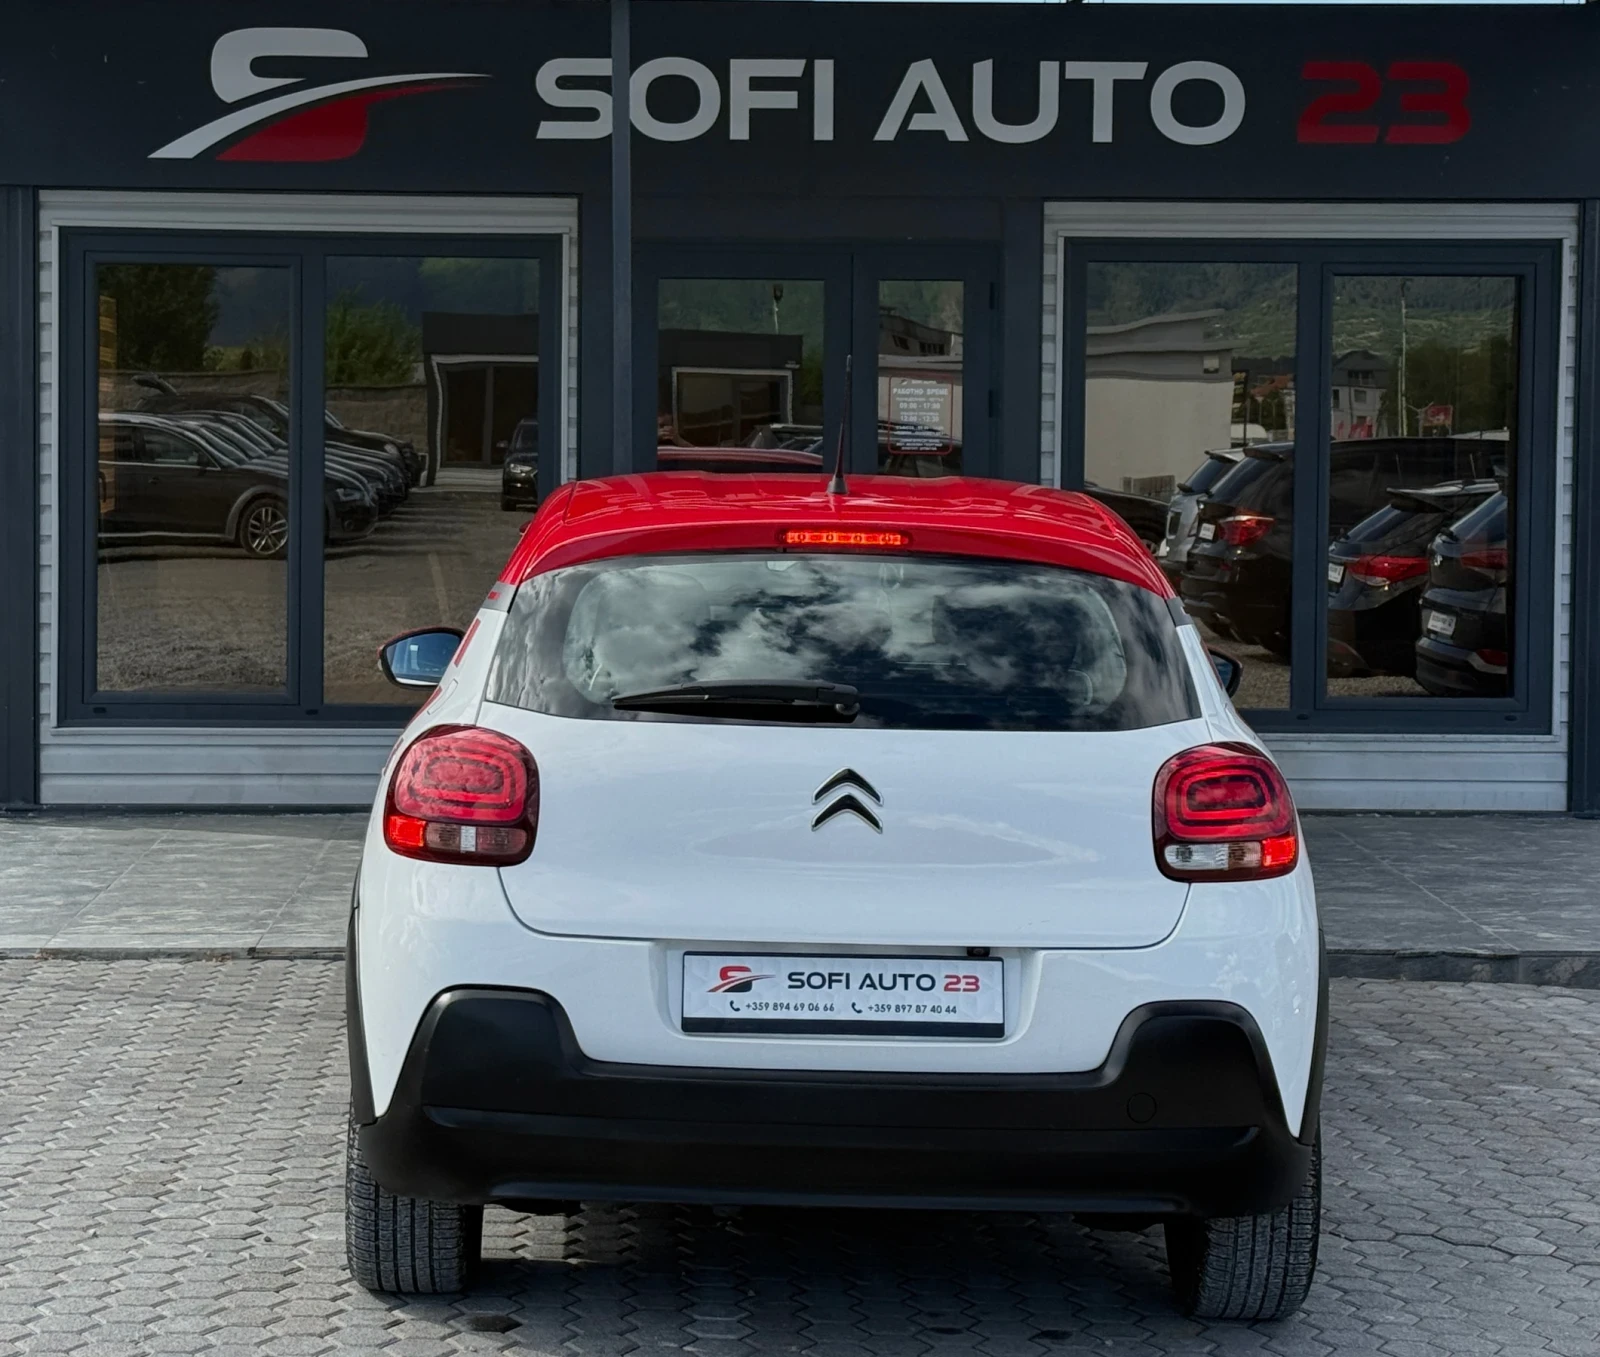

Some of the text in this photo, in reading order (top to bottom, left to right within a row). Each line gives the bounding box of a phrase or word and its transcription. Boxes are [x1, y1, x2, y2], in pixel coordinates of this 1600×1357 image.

[535, 57, 1472, 145] SOFI AUTO 23
[787, 971, 981, 993] SOFI AUTO 23
[745, 1001, 835, 1012] +359 894 69 06 66
[867, 1004, 957, 1014] +359 897 87 40 44
